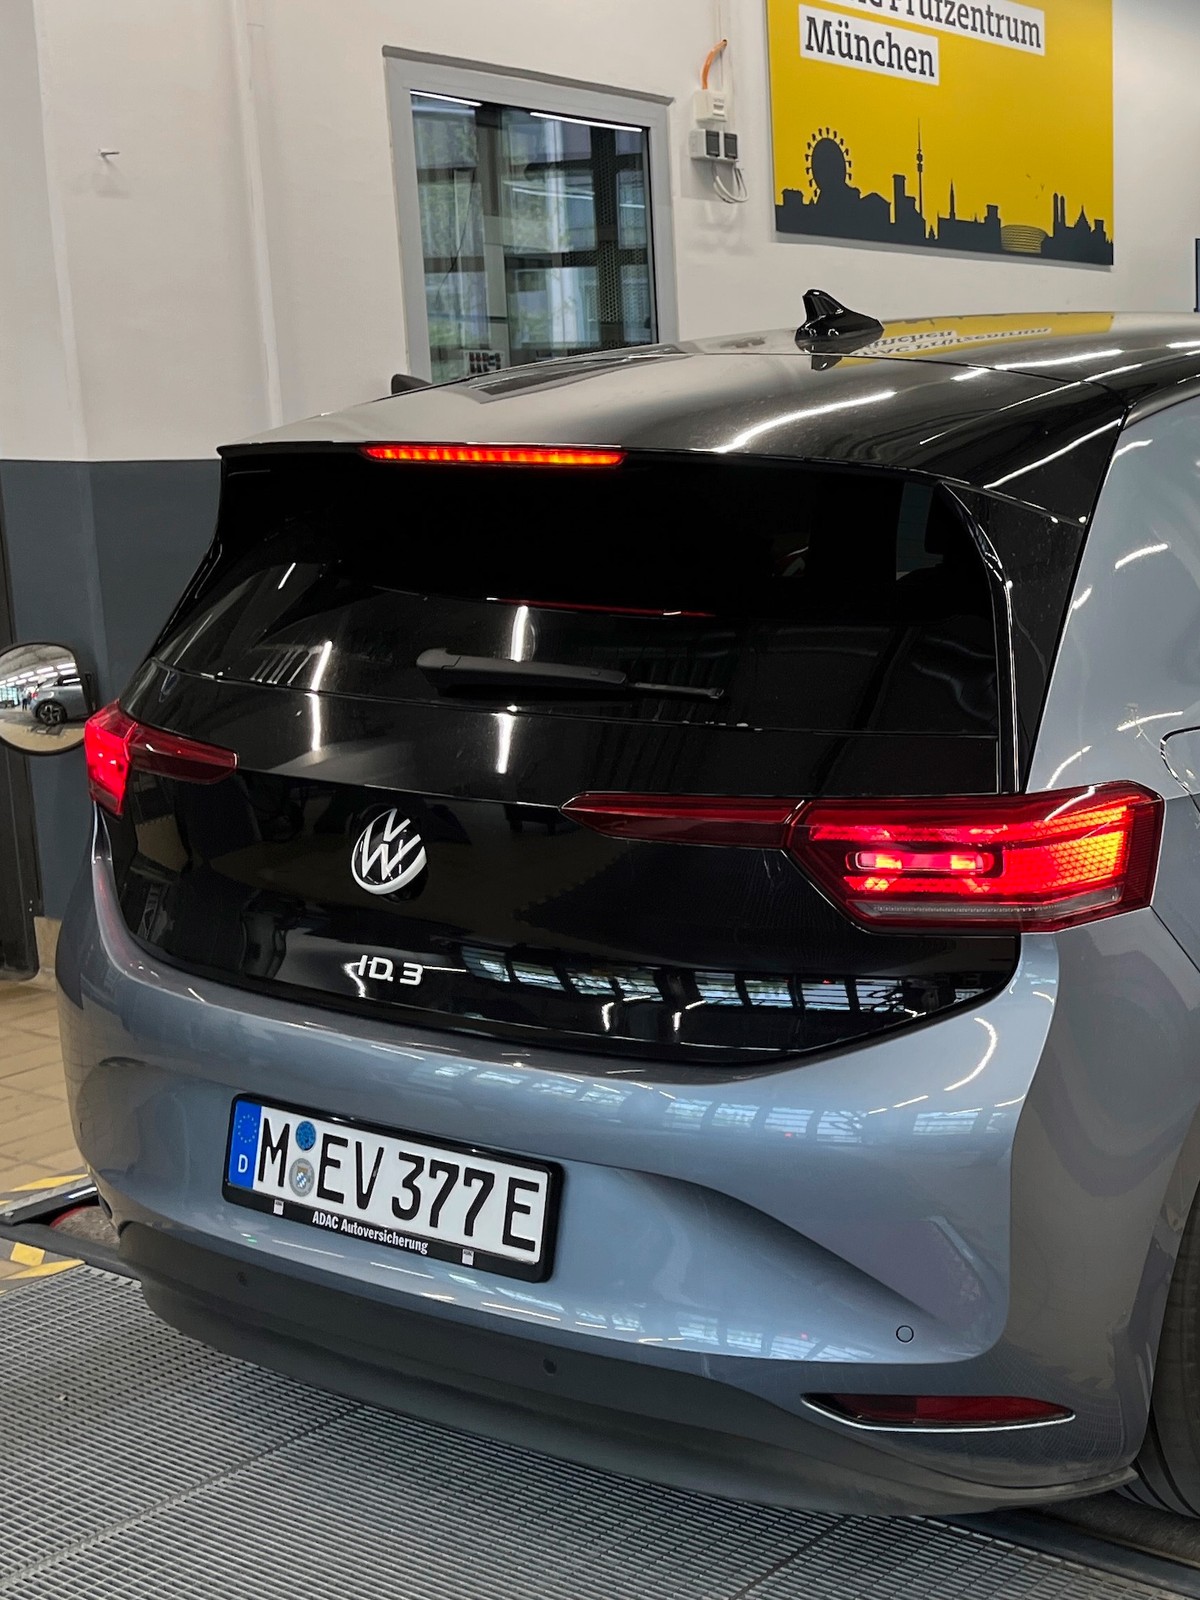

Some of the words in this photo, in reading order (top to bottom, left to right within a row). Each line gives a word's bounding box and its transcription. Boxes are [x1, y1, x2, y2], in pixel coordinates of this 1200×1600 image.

[805, 16, 935, 77] München
[237, 1153, 249, 1173] D
[258, 1117, 290, 1187] M
[312, 1211, 339, 1229] ADAC
[341, 1219, 429, 1255] Autoversicherung
